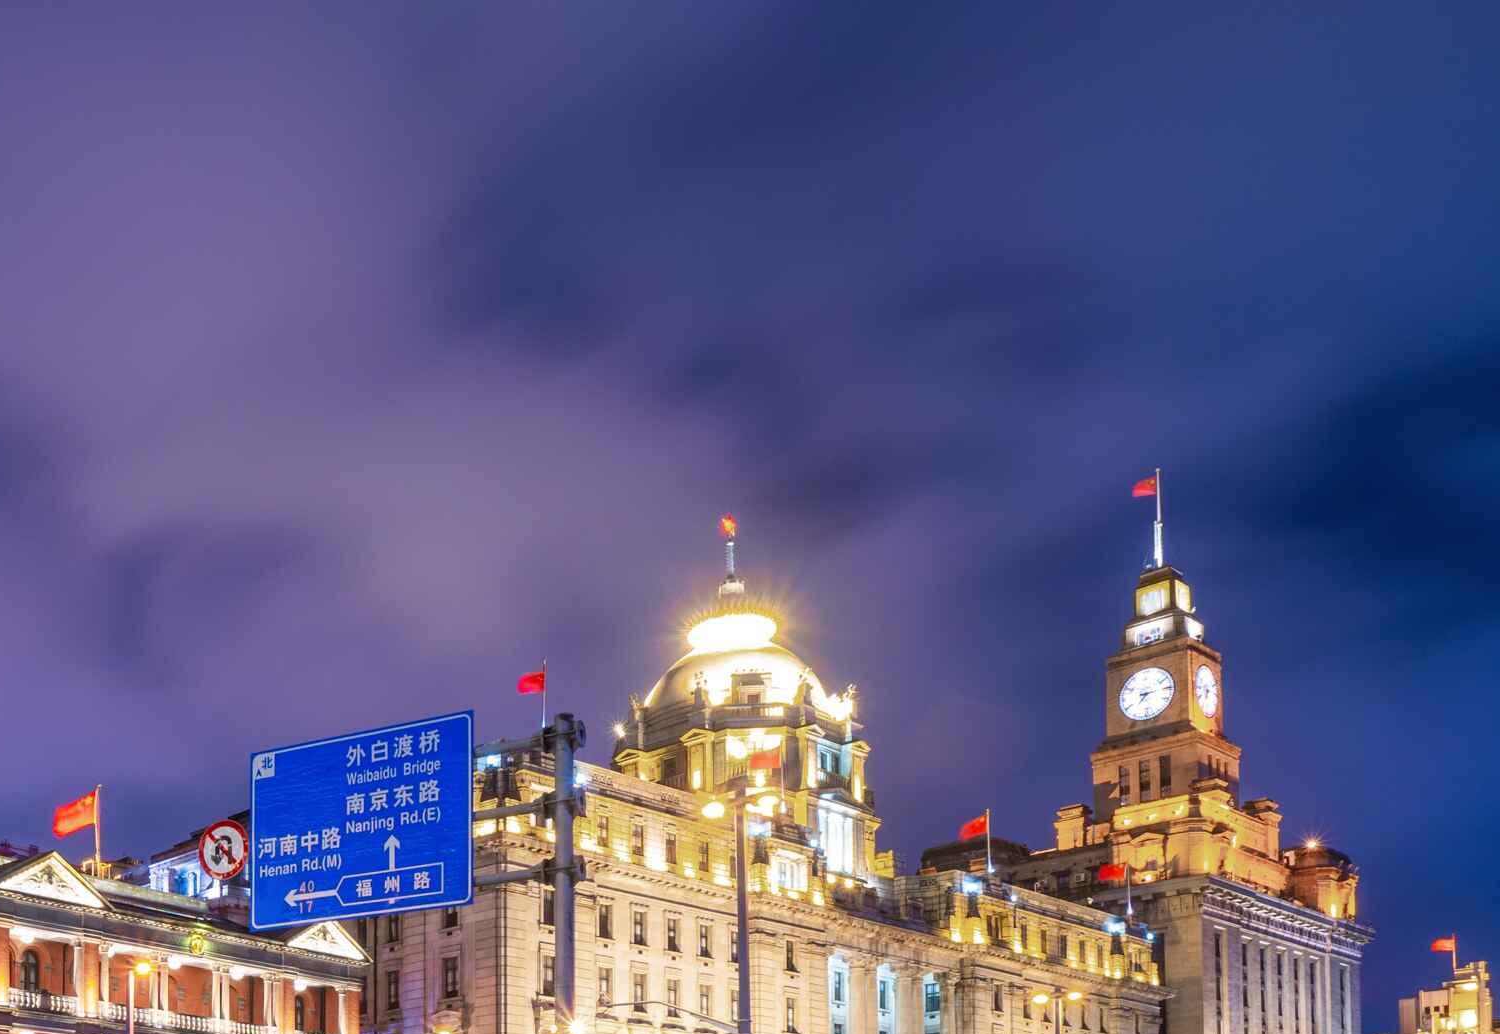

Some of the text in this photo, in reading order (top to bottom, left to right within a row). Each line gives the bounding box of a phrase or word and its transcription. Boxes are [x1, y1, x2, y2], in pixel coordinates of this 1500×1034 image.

[346, 729, 440, 767] 外白渡桥
[261, 755, 274, 769] 北
[346, 759, 441, 785] Waibaidu Bridge
[345, 779, 440, 815] 南京东路
[346, 807, 441, 834] Nanjing Rd.(E)
[258, 827, 341, 859] 河南中路
[259, 853, 342, 878] Henan Rd.(M)
[355, 871, 432, 898] 福州路
